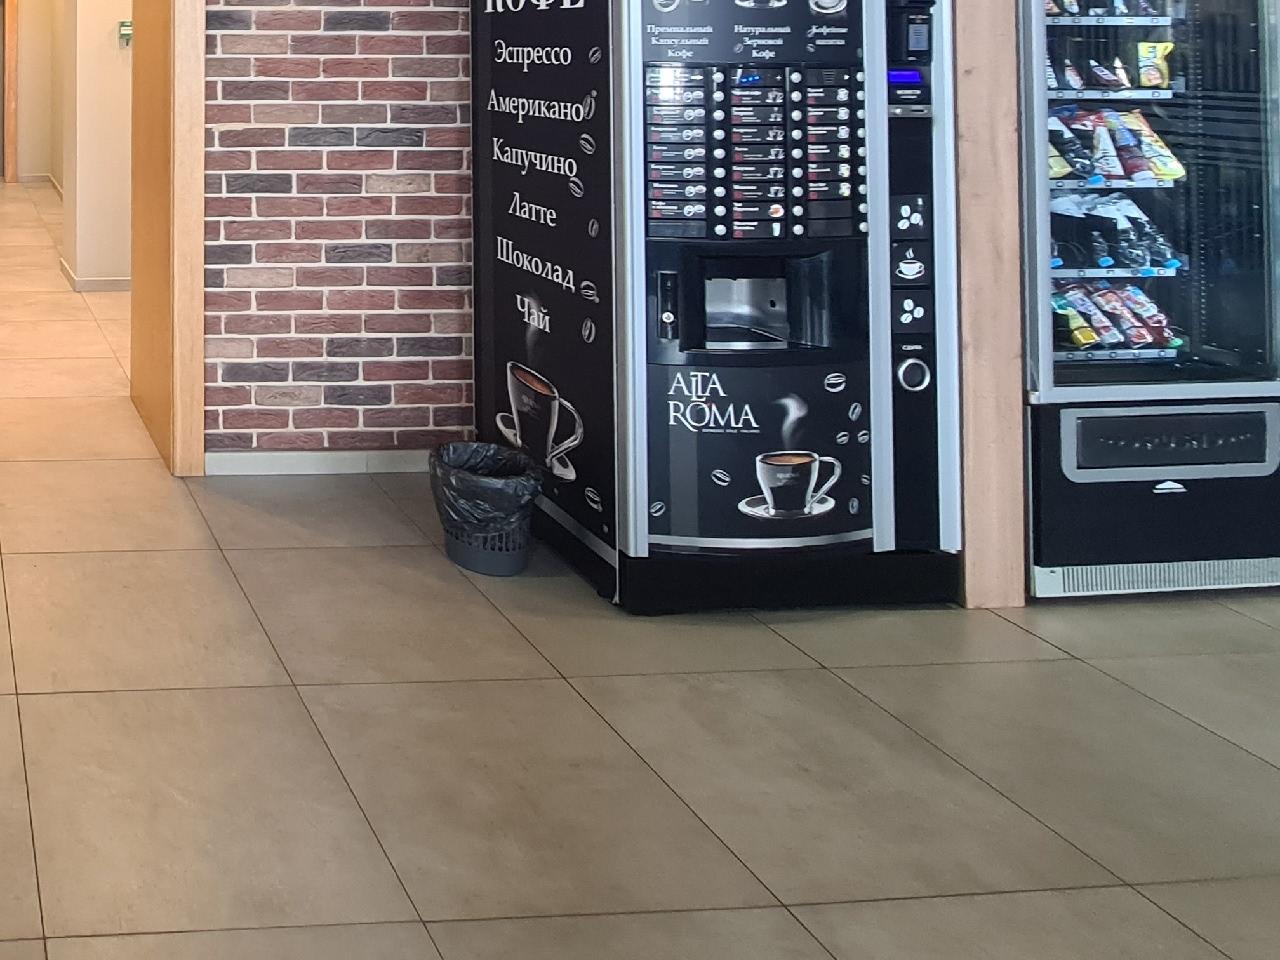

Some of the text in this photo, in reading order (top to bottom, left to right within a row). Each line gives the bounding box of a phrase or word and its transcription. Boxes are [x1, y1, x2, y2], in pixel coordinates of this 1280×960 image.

[494, 40, 571, 71] Эспрессо
[667, 49, 694, 59] Кофе
[751, 49, 776, 59] Кофе
[487, 88, 583, 123] Американо
[492, 137, 577, 177] Капучино
[508, 192, 557, 227] Латте
[496, 236, 575, 293] Шоколад
[515, 294, 551, 334] Чай
[667, 400, 760, 432] ROMA
